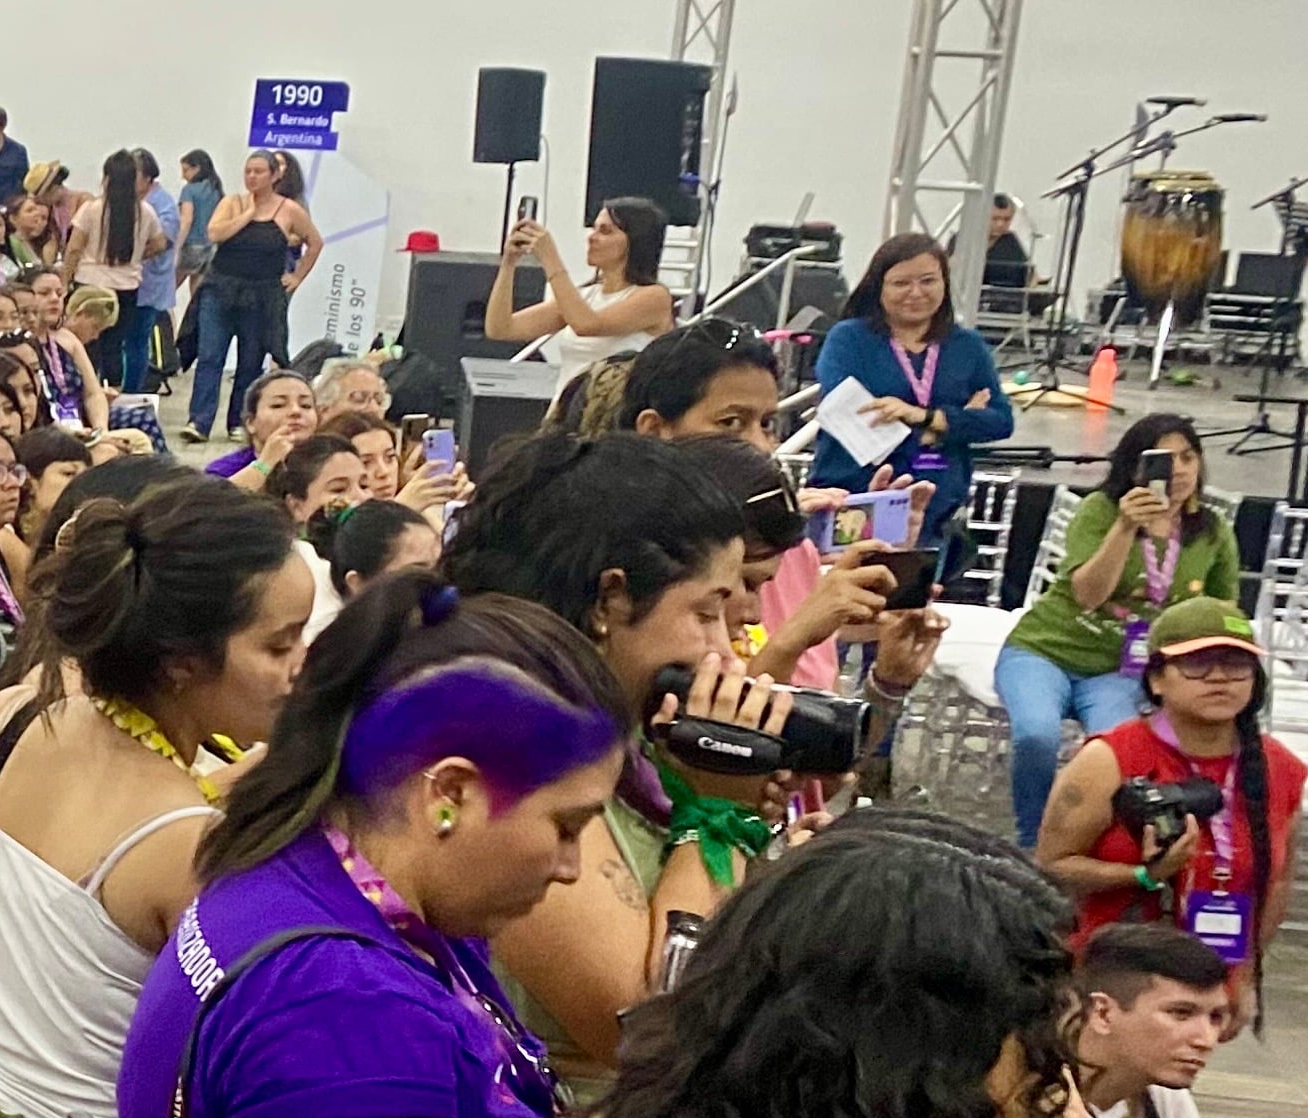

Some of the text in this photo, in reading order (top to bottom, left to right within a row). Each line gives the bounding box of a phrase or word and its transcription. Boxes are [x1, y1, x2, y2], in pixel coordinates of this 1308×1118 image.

[271, 83, 324, 106] 1990
[266, 112, 330, 127] S. Bernardo
[263, 130, 323, 147] Argentina
[324, 263, 345, 342] eminismo
[345, 314, 364, 337] los
[698, 736, 753, 758] Canon
